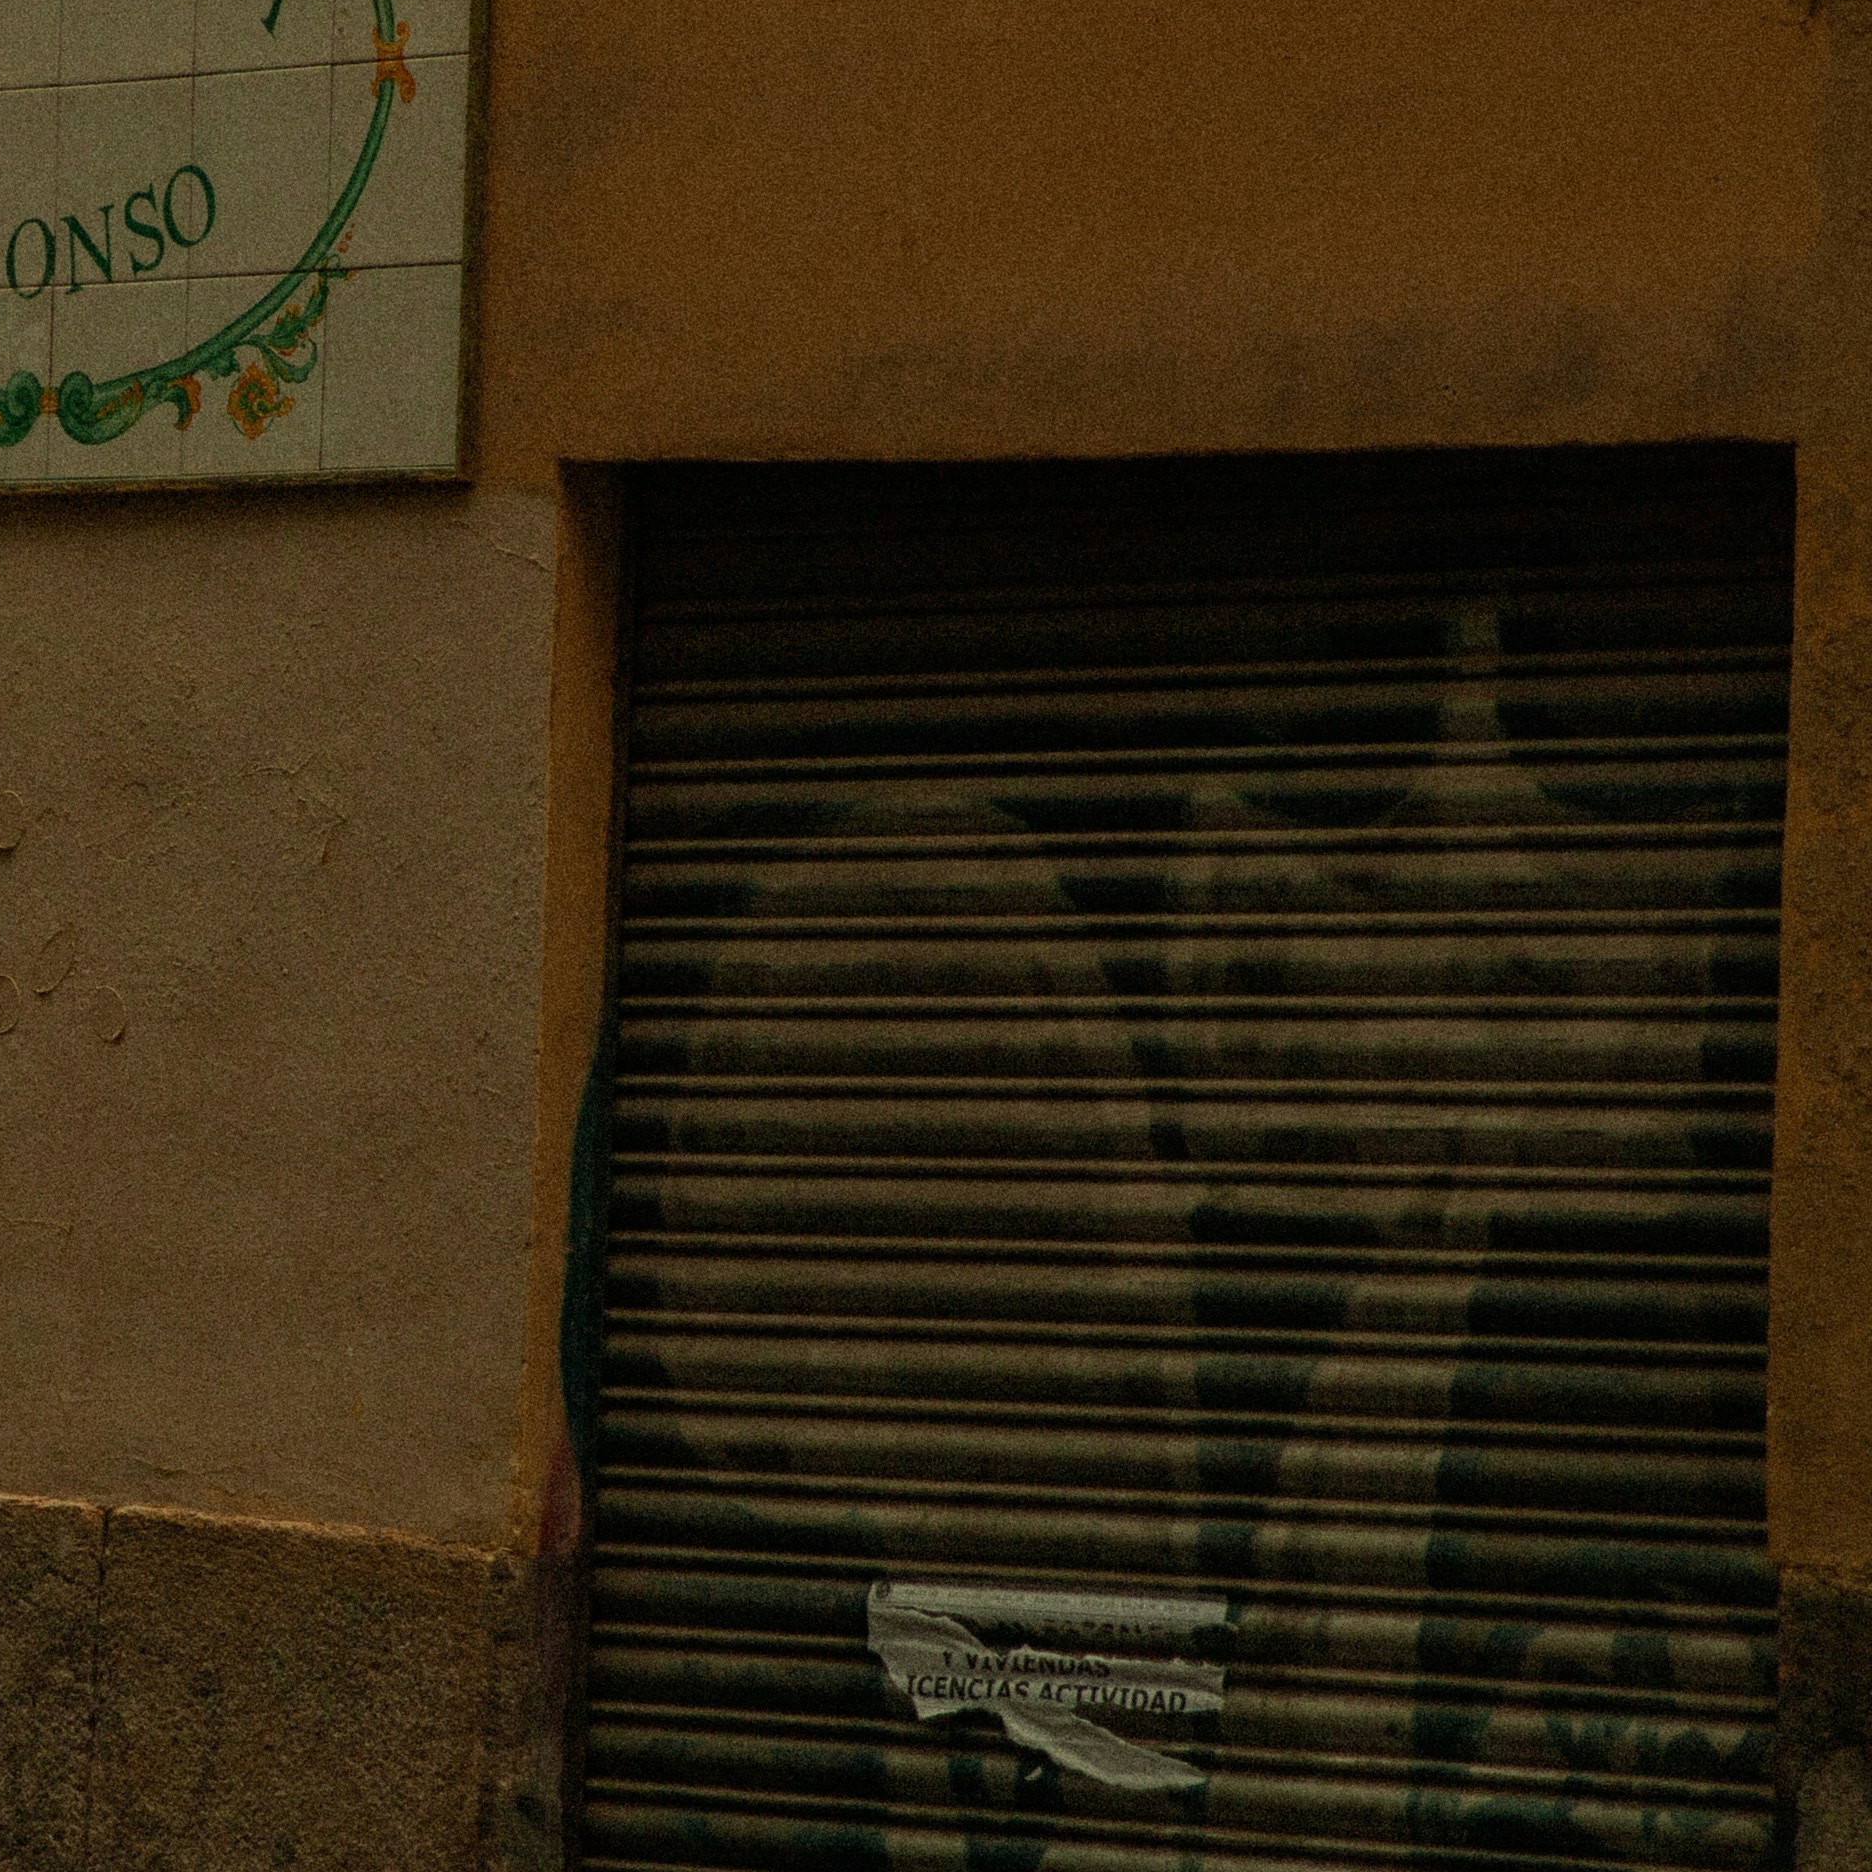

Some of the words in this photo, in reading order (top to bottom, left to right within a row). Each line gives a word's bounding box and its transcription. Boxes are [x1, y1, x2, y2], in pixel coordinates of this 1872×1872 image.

[964, 1651, 1111, 1677] VIVIENDAS
[904, 1674, 1029, 1699] ICENCIAS
[1038, 1681, 1187, 1712] ACTIVIDAD
